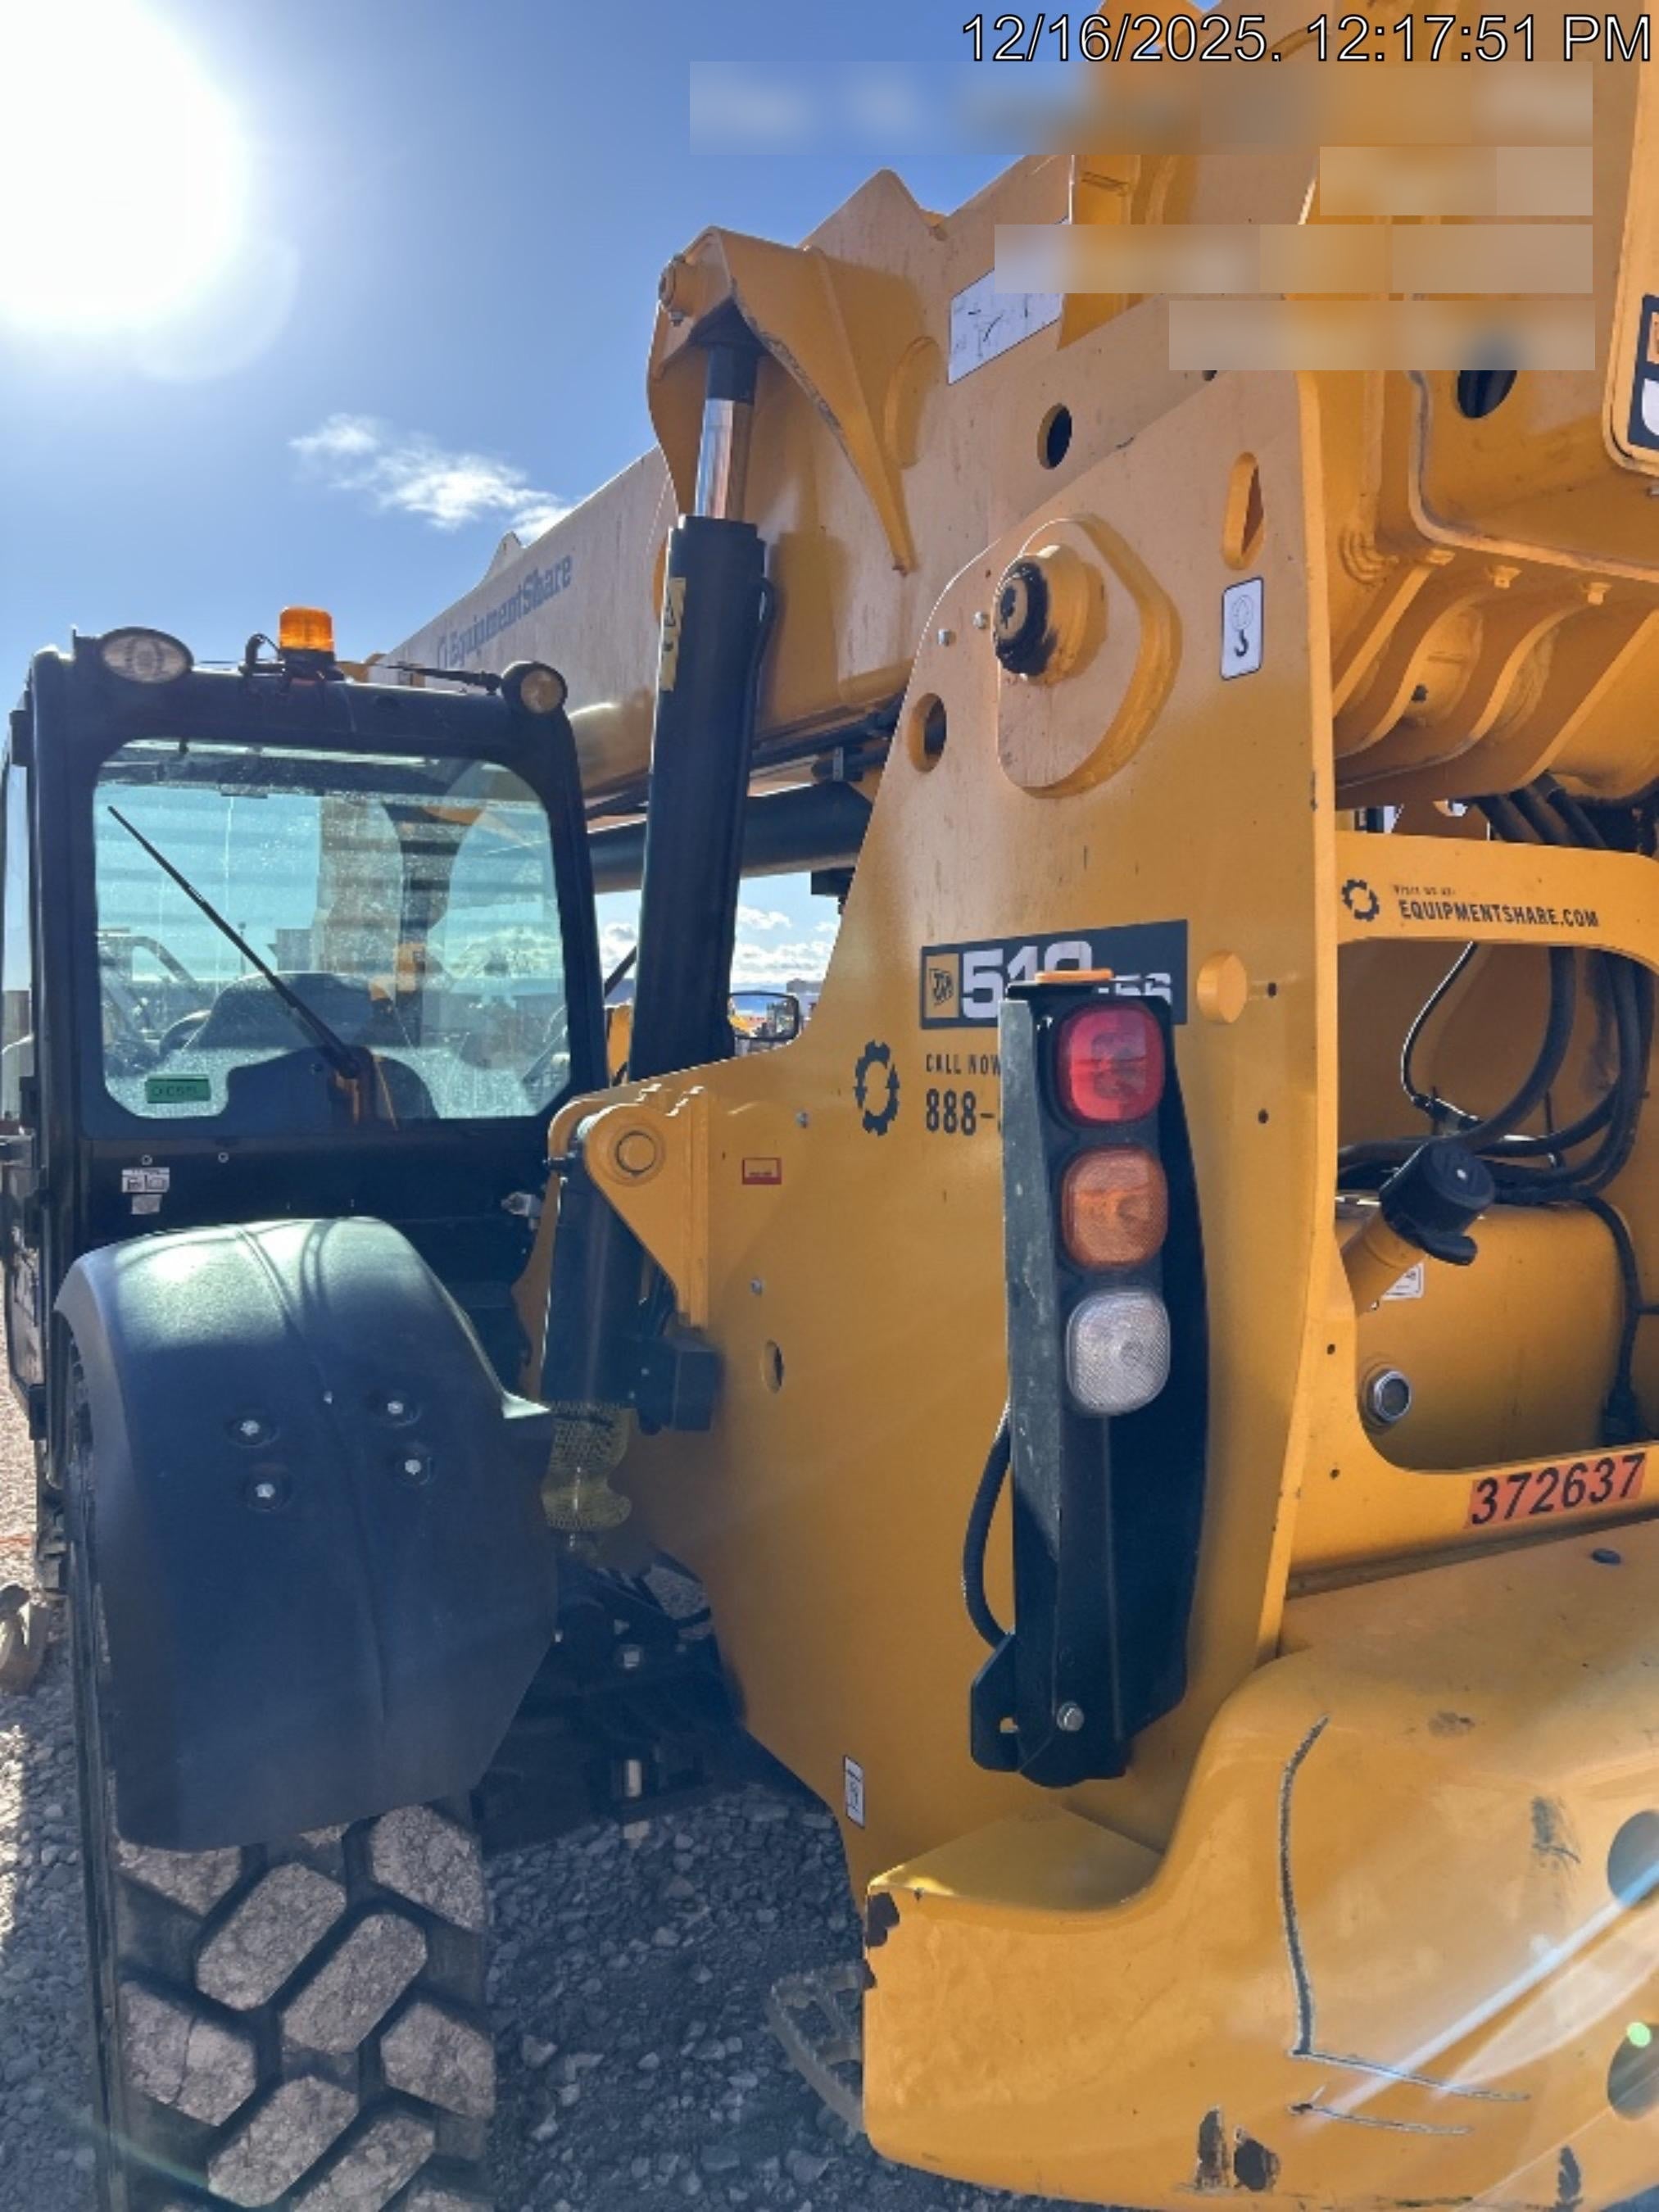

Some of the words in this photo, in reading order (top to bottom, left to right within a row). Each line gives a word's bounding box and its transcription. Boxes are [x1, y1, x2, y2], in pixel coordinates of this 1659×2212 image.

[1398, 900, 1599, 927] EQUIPMENTSHARE.COM
[926, 1054, 962, 1075] CALL
[926, 1087, 1000, 1136] 888-
[1471, 1452, 1645, 1525] 372637
